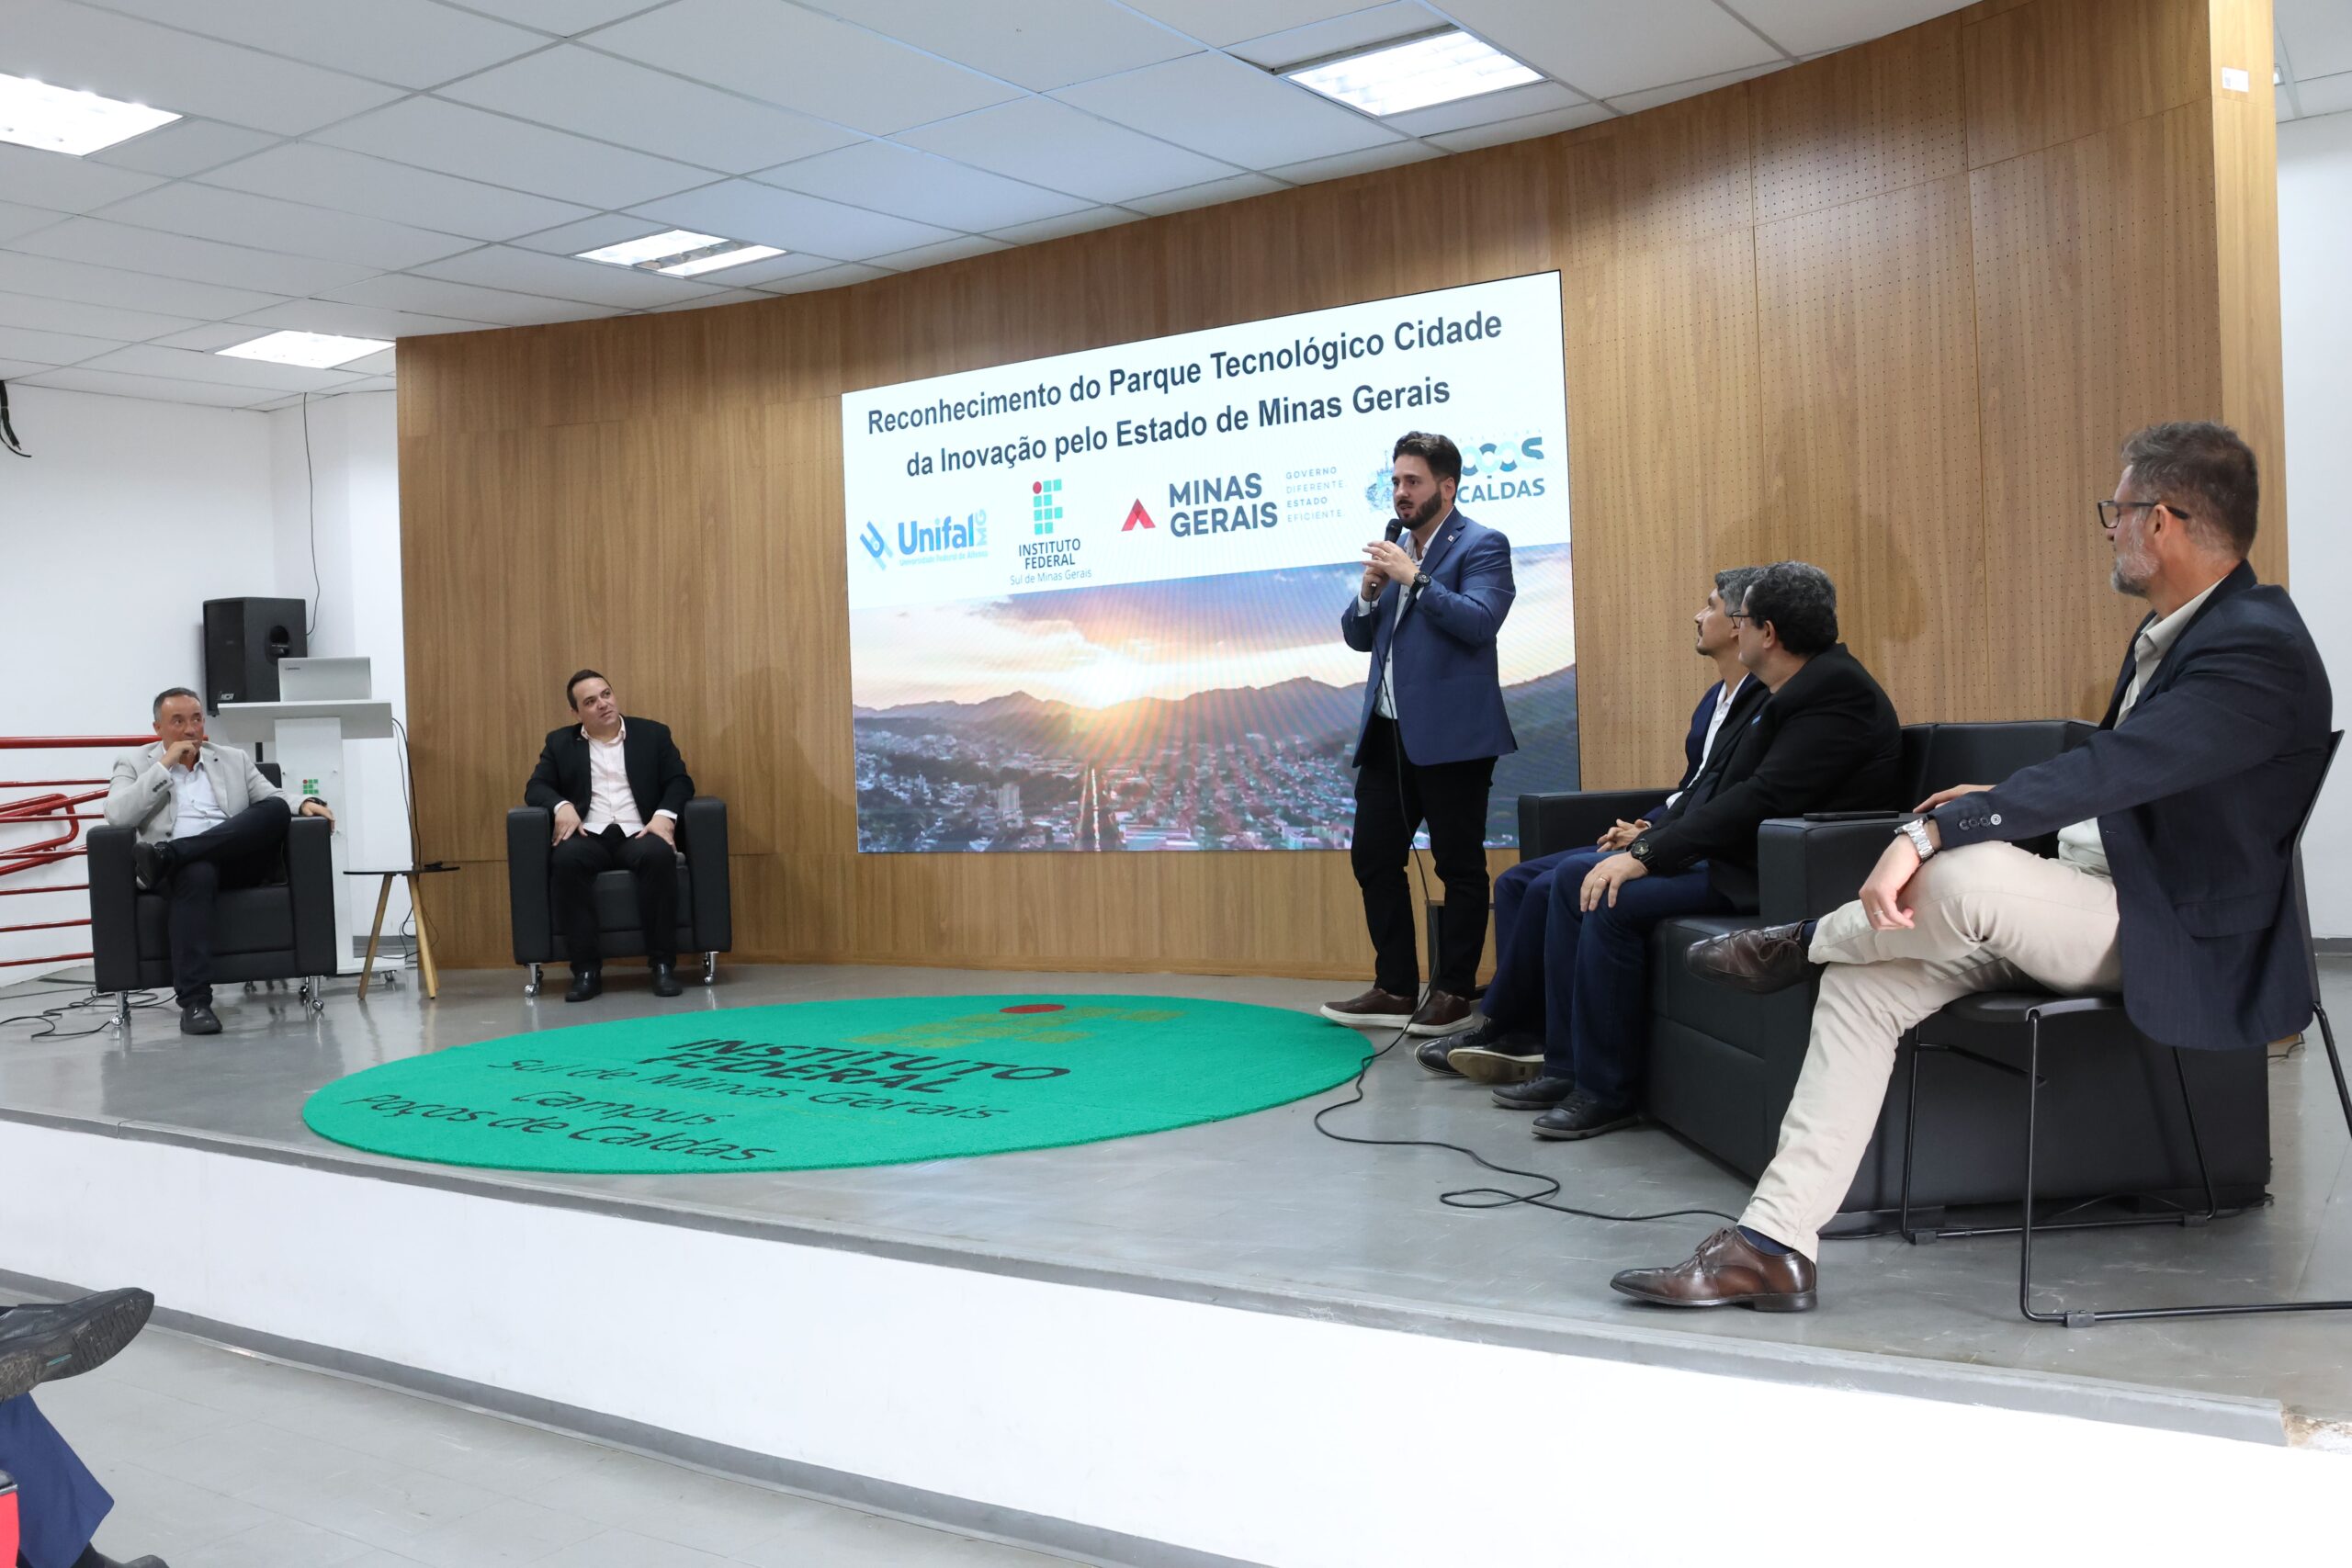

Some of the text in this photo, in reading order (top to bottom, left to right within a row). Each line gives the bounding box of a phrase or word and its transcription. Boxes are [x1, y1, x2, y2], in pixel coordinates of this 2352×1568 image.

[868, 310, 1502, 434] Reconhecimento do Parque Tecnológico Cidade
[907, 377, 1451, 477] da Inovação pelo Estado de Minas Gerais
[1169, 472, 1262, 508] MINAS
[1286, 467, 1338, 479] GOVERNO
[1457, 478, 1545, 503] CALDAS
[1170, 502, 1279, 537] GERAIS
[1286, 496, 1329, 508] ESTADO
[898, 513, 975, 555] Unifal
[975, 508, 989, 547] MG
[1018, 538, 1080, 557] INSTITUTO
[1024, 553, 1076, 570] FEDERAL
[1010, 569, 1091, 586] Sul de Minas Gerais
[636, 1053, 962, 1094] FEDERAL
[667, 1038, 1071, 1080] INSTITUTO
[488, 1059, 1014, 1119] Sul de Minas Gerais
[512, 1090, 735, 1125] Campus
[341, 1094, 777, 1161] Poços de Caldas
